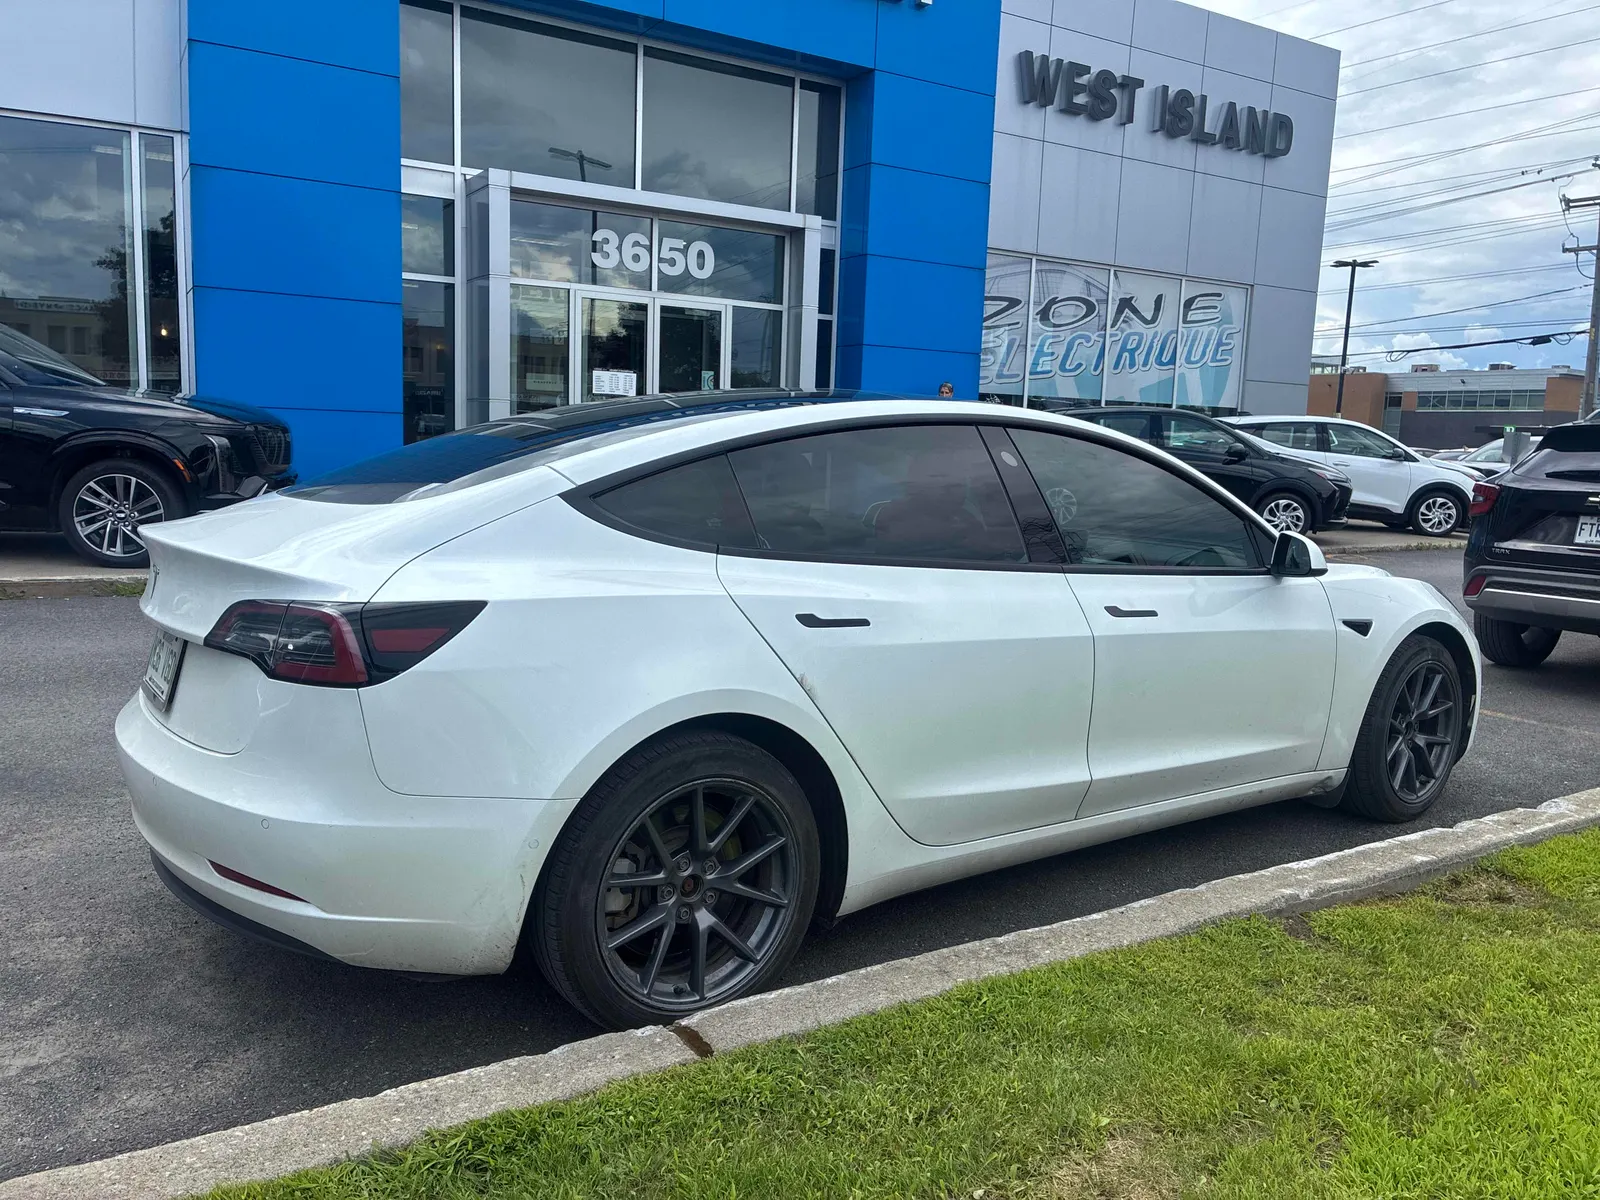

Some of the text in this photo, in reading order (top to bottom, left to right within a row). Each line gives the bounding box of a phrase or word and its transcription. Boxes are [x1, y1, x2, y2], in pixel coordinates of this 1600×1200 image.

[1017, 50, 1294, 158] WEST ISLAND
[591, 229, 715, 279] 3650
[983, 292, 1223, 331] ZONE
